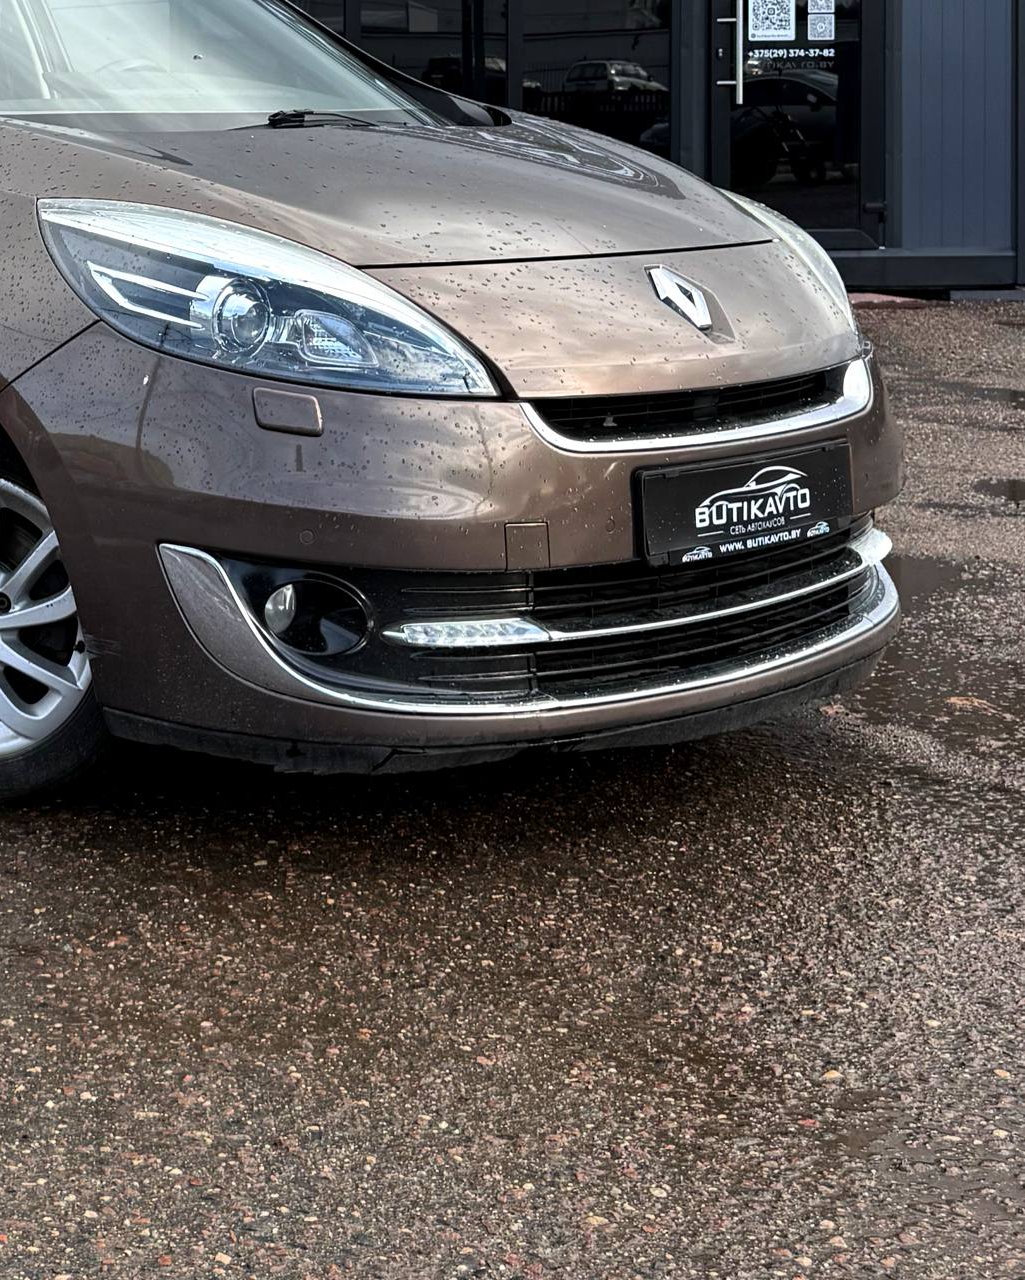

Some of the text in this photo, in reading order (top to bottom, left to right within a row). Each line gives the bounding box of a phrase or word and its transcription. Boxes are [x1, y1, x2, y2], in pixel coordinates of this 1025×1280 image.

[747, 48, 836, 59] +375(29) 374-37-82
[695, 487, 811, 528] BUTIKAVTO
[729, 516, 785, 535] СЕТЬ АВТОХАУСОВ
[719, 528, 801, 553] WWW. BUTIKAVTO.BY
